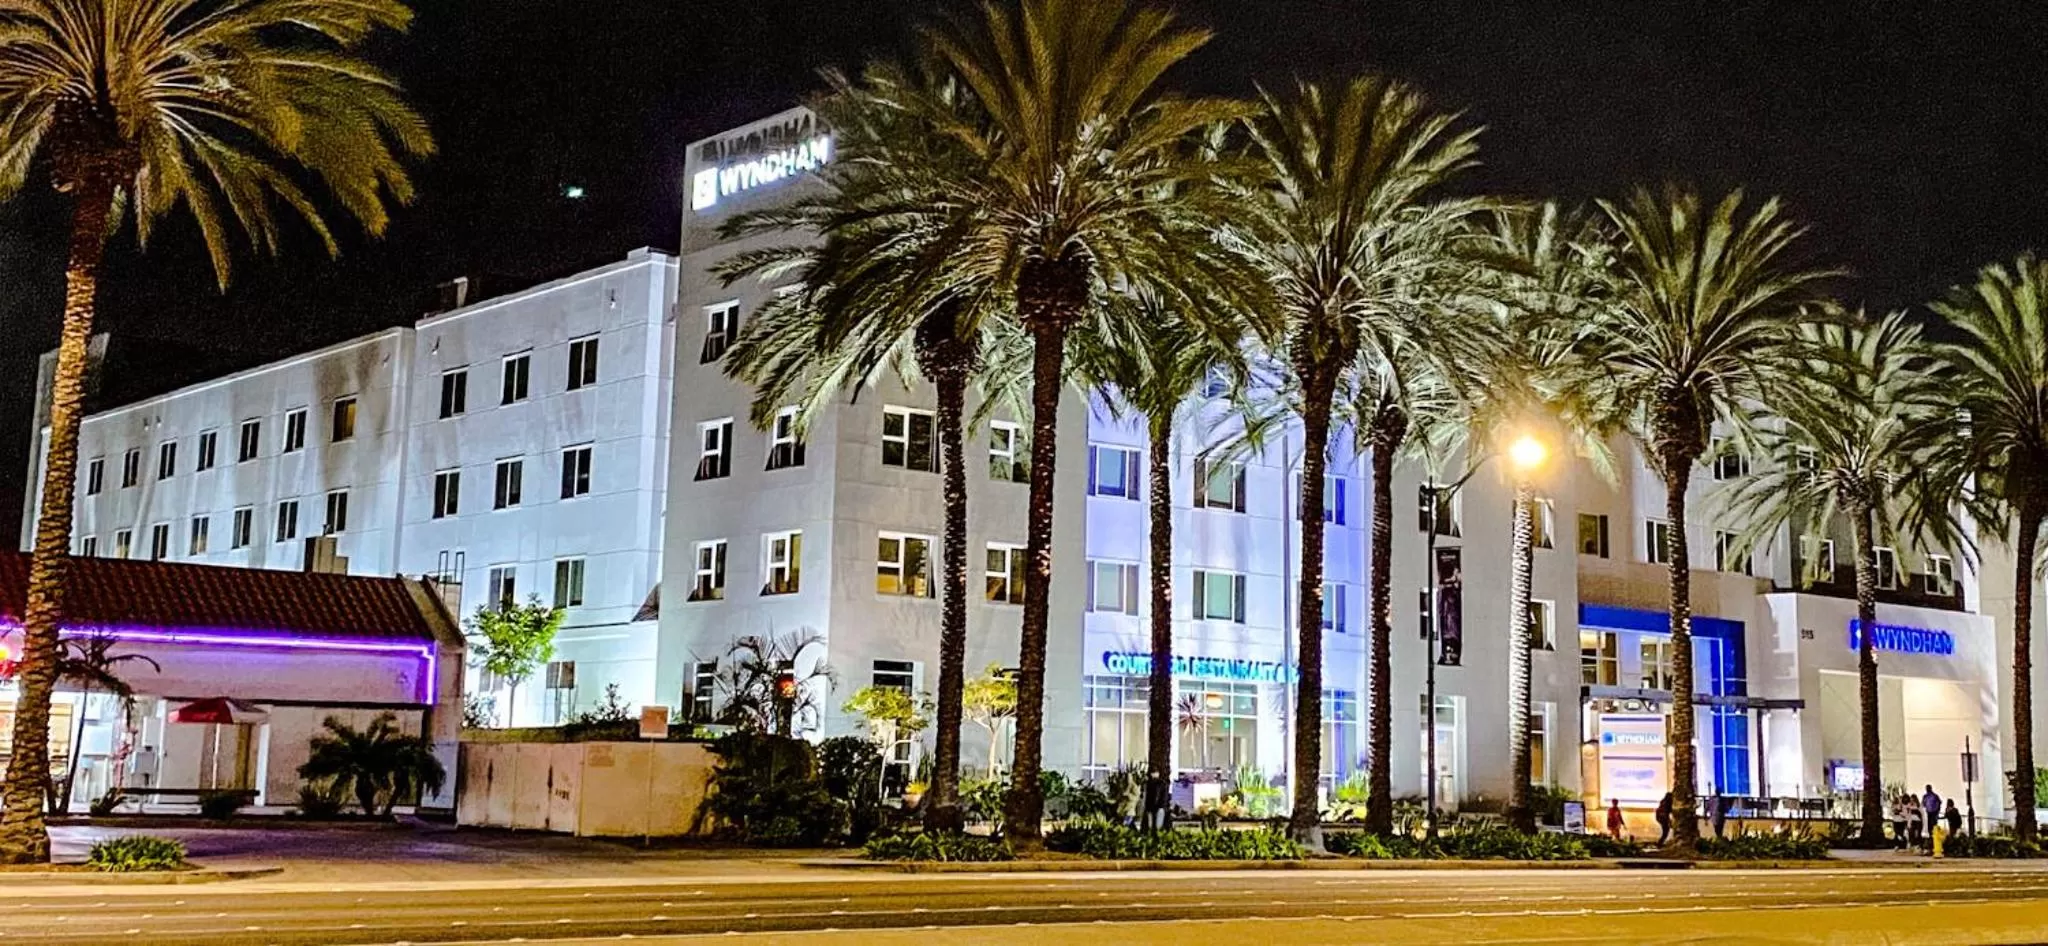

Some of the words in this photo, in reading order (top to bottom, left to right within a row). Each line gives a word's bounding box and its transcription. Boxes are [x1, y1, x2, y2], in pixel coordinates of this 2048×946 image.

[720, 136, 830, 196] WYNDHAM
[1874, 626, 1957, 653] WYNDHAM
[1105, 652, 1189, 677] COURTRD
